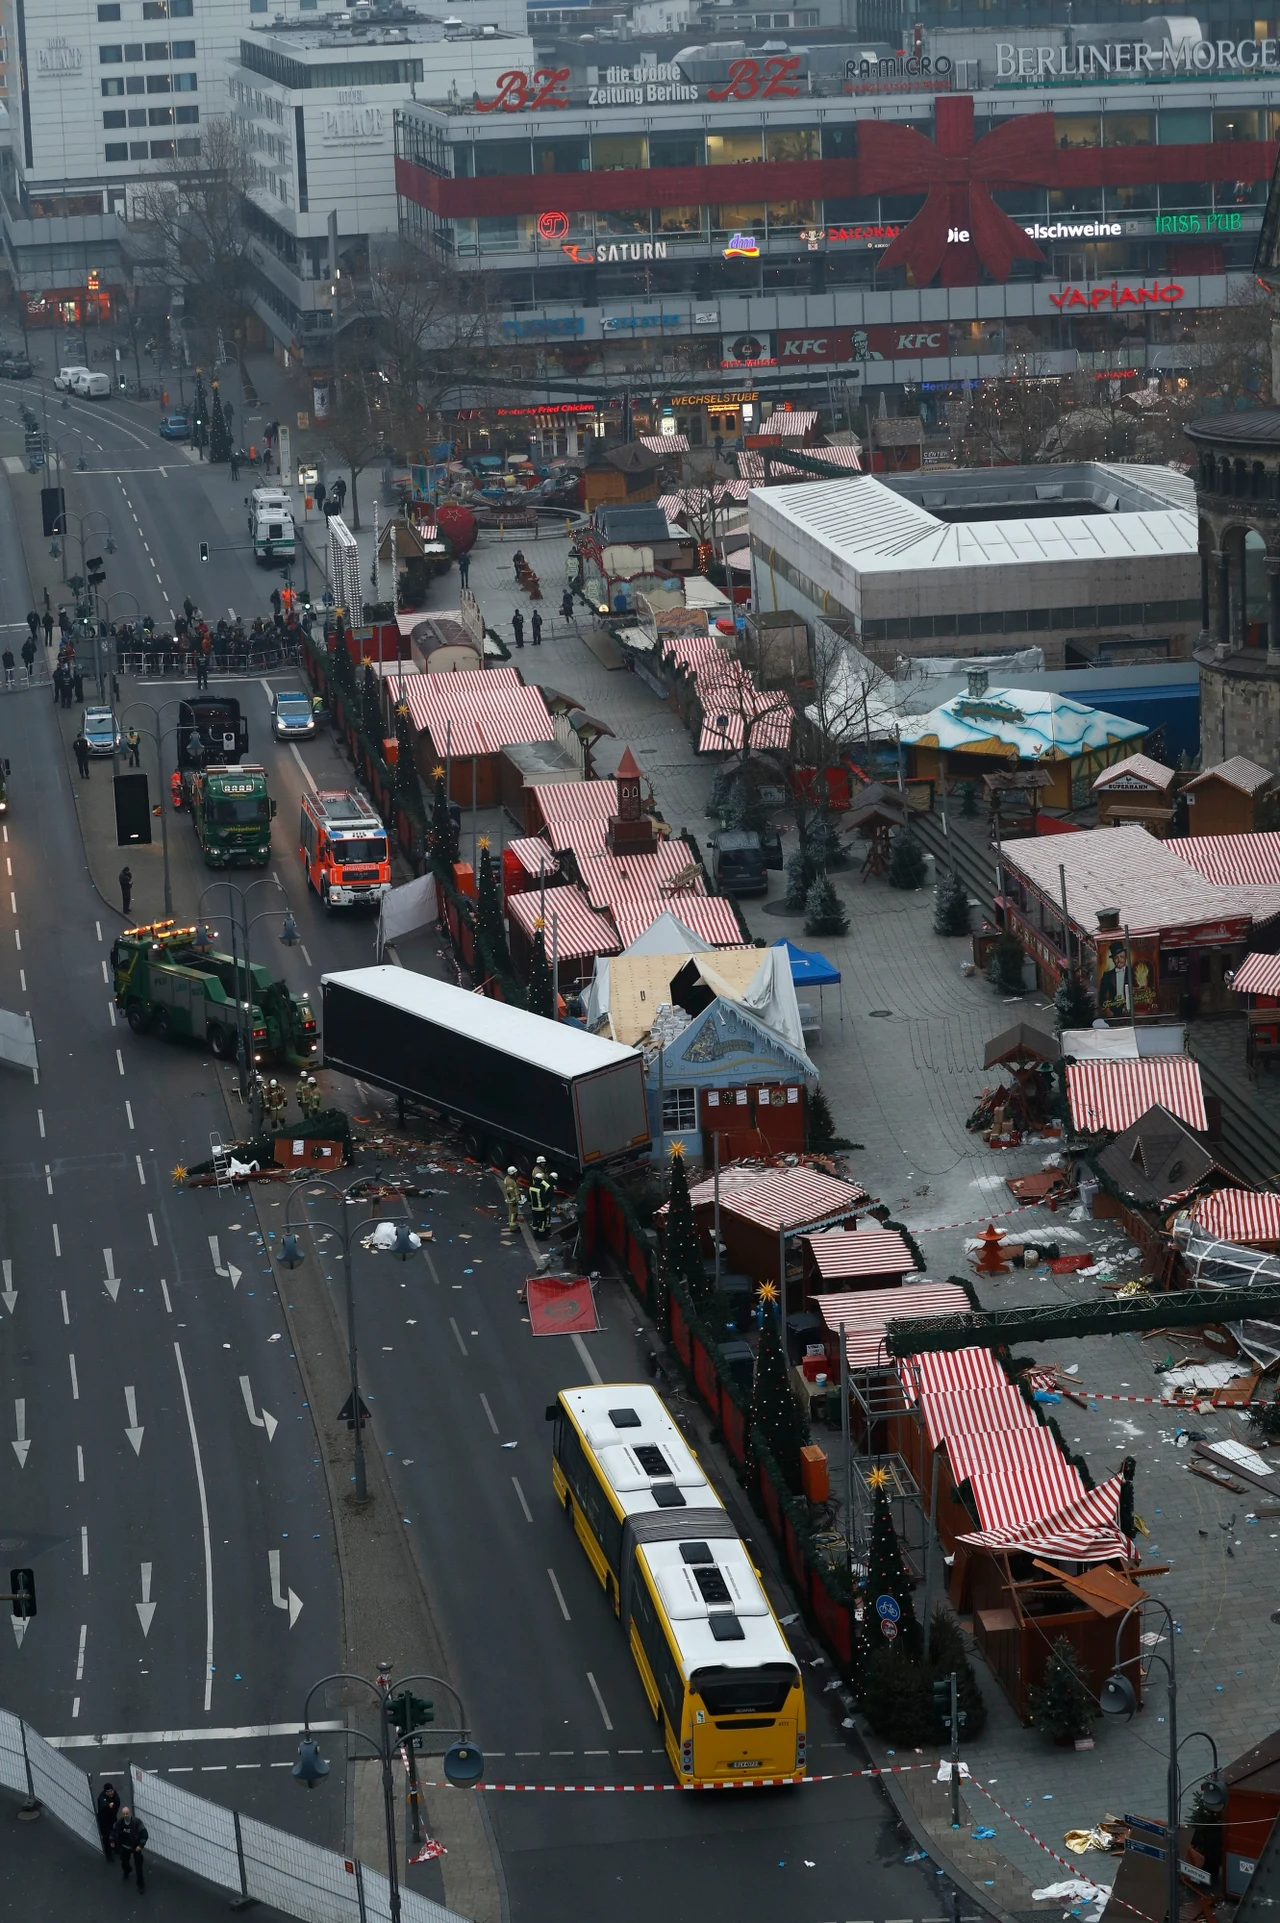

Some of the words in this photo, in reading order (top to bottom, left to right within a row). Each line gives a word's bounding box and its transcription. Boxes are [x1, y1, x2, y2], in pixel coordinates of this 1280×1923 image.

[995, 43, 1153, 77] BERLINER
[1162, 37, 1280, 71] MORGE
[606, 66, 630, 84] die
[633, 62, 681, 85] größte
[588, 85, 643, 105] Zeitung
[647, 83, 698, 102] Berlins
[321, 108, 384, 139] PALACE
[1207, 212, 1242, 231] PUB
[730, 232, 755, 249] dm
[597, 242, 667, 262] SATURN
[1049, 280, 1184, 310] VAPIANO
[783, 339, 828, 355] KFC
[897, 333, 942, 349] KFC
[720, 360, 742, 369] CITY
[746, 357, 778, 368] MUSIC
[538, 405, 560, 414] Fried
[561, 403, 595, 413] Chicken
[671, 392, 759, 406] WECHSELSTUBE
